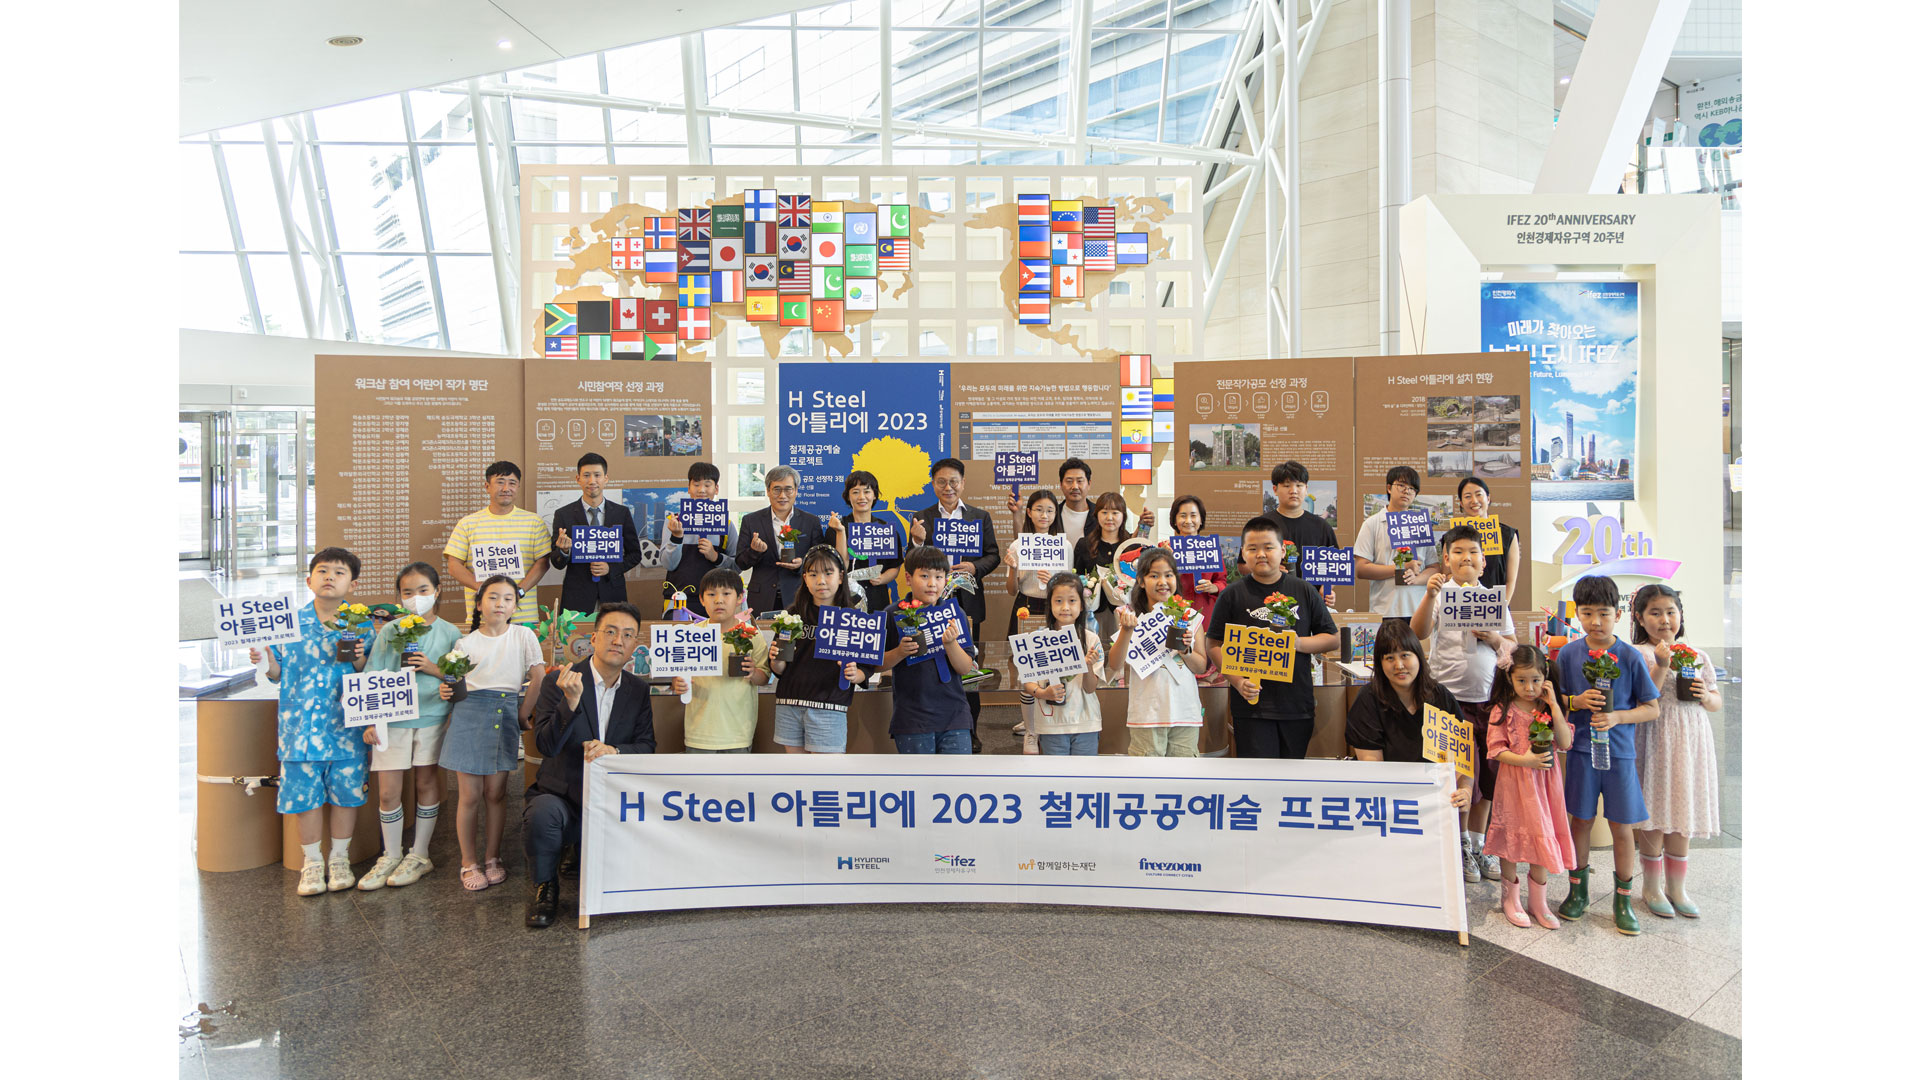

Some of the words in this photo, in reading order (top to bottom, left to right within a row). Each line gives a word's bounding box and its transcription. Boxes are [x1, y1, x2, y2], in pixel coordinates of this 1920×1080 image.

[1507, 215, 1531, 225] IFEZ
[1534, 213, 1556, 225] 20th
[1556, 214, 1636, 225] ANNIVERSARY
[1517, 232, 1590, 244] 인천경제자유구역
[1594, 232, 1624, 244] 20주년
[1508, 320, 1544, 336] 미래가
[1547, 322, 1596, 339] 찾아오는
[1542, 344, 1572, 364] 도시
[1578, 345, 1619, 364] IFEZ
[355, 378, 386, 390] 워크샵
[389, 378, 410, 390] 참여
[413, 378, 442, 390] 어린이
[446, 379, 466, 390] 작가
[469, 380, 488, 391] 명단
[1216, 379, 1267, 390] 전문작가공모
[1270, 378, 1287, 389] 선정
[1289, 378, 1308, 388] 과정
[1397, 376, 1417, 384] Steel
[1420, 374, 1453, 385] 아틀리에
[1456, 373, 1473, 384] 설치
[1476, 373, 1494, 384] 현황
[578, 381, 623, 392] 시민참여작
[626, 381, 643, 392] 선정
[646, 382, 664, 392] 과정
[788, 391, 802, 408] H
[813, 390, 865, 408] Steel
[788, 412, 868, 433] 아틀리에
[878, 413, 927, 430] 2023
[789, 445, 840, 455] 철제공공예술
[789, 456, 823, 466] 프로젝트
[998, 455, 1005, 463] H
[1009, 454, 1035, 464] Steel
[996, 465, 1036, 476] 아틀리에
[683, 502, 692, 512] H
[696, 502, 725, 512] Steel
[682, 513, 726, 526] 아틀리에
[1389, 515, 1397, 525] H
[1401, 512, 1427, 524] Steel
[1467, 519, 1495, 530] Steel
[576, 529, 585, 539] H
[589, 529, 619, 539] Steel
[852, 526, 860, 536] H
[865, 525, 893, 536] Steel
[938, 522, 945, 531] H
[950, 522, 979, 533] Steel
[1390, 524, 1430, 539] 아틀리에
[574, 540, 620, 553] 아틀리에
[851, 537, 894, 550] 아틀리에
[936, 533, 980, 547] 아틀리에
[1022, 537, 1029, 546] H
[1034, 537, 1062, 546] Steel
[1173, 540, 1182, 549] H
[1186, 538, 1216, 549] Steel
[1555, 516, 1653, 564] 20th
[475, 548, 484, 557] H
[488, 545, 517, 556] Steel
[1021, 549, 1064, 560] 아틀리에
[1174, 549, 1219, 564] 아틀리에
[1306, 550, 1314, 560] H
[1319, 550, 1350, 560] Steel
[476, 557, 520, 571] 아틀리에
[1304, 563, 1351, 576] 아틀리에
[1446, 592, 1456, 602] H
[1463, 591, 1501, 602] Steel
[220, 604, 234, 617] H
[242, 596, 289, 615] Steel
[1444, 606, 1502, 619] 아틀리에
[220, 613, 294, 636] 아틀리에
[823, 610, 834, 625] H
[841, 612, 881, 630] Steel
[656, 630, 667, 643] H
[675, 629, 715, 643] Steel
[819, 628, 881, 651] 아틀리에
[1015, 639, 1027, 652] H
[1032, 631, 1073, 649] Steel
[1229, 629, 1241, 643] H
[1248, 631, 1290, 649] Steel
[654, 646, 717, 663] 아틀리에
[1018, 646, 1080, 669] 아틀리에
[1226, 646, 1290, 668] 아틀리에
[349, 678, 360, 692] H
[368, 672, 410, 690] Steel
[348, 689, 413, 712] 아틀리에
[1429, 710, 1436, 726] H
[1441, 716, 1469, 740] Steel
[1427, 729, 1470, 762] 아틀리에
[620, 791, 645, 823] H
[662, 791, 756, 823] Steel
[771, 790, 916, 828] 아틀리에
[932, 793, 1022, 824] 2023
[1039, 791, 1262, 831] 철제공공예술
[1278, 796, 1424, 837] 프로젝트
[951, 855, 975, 867] ifez
[1037, 861, 1096, 871] 함께일하는재단
[1139, 858, 1201, 872] freezoom
